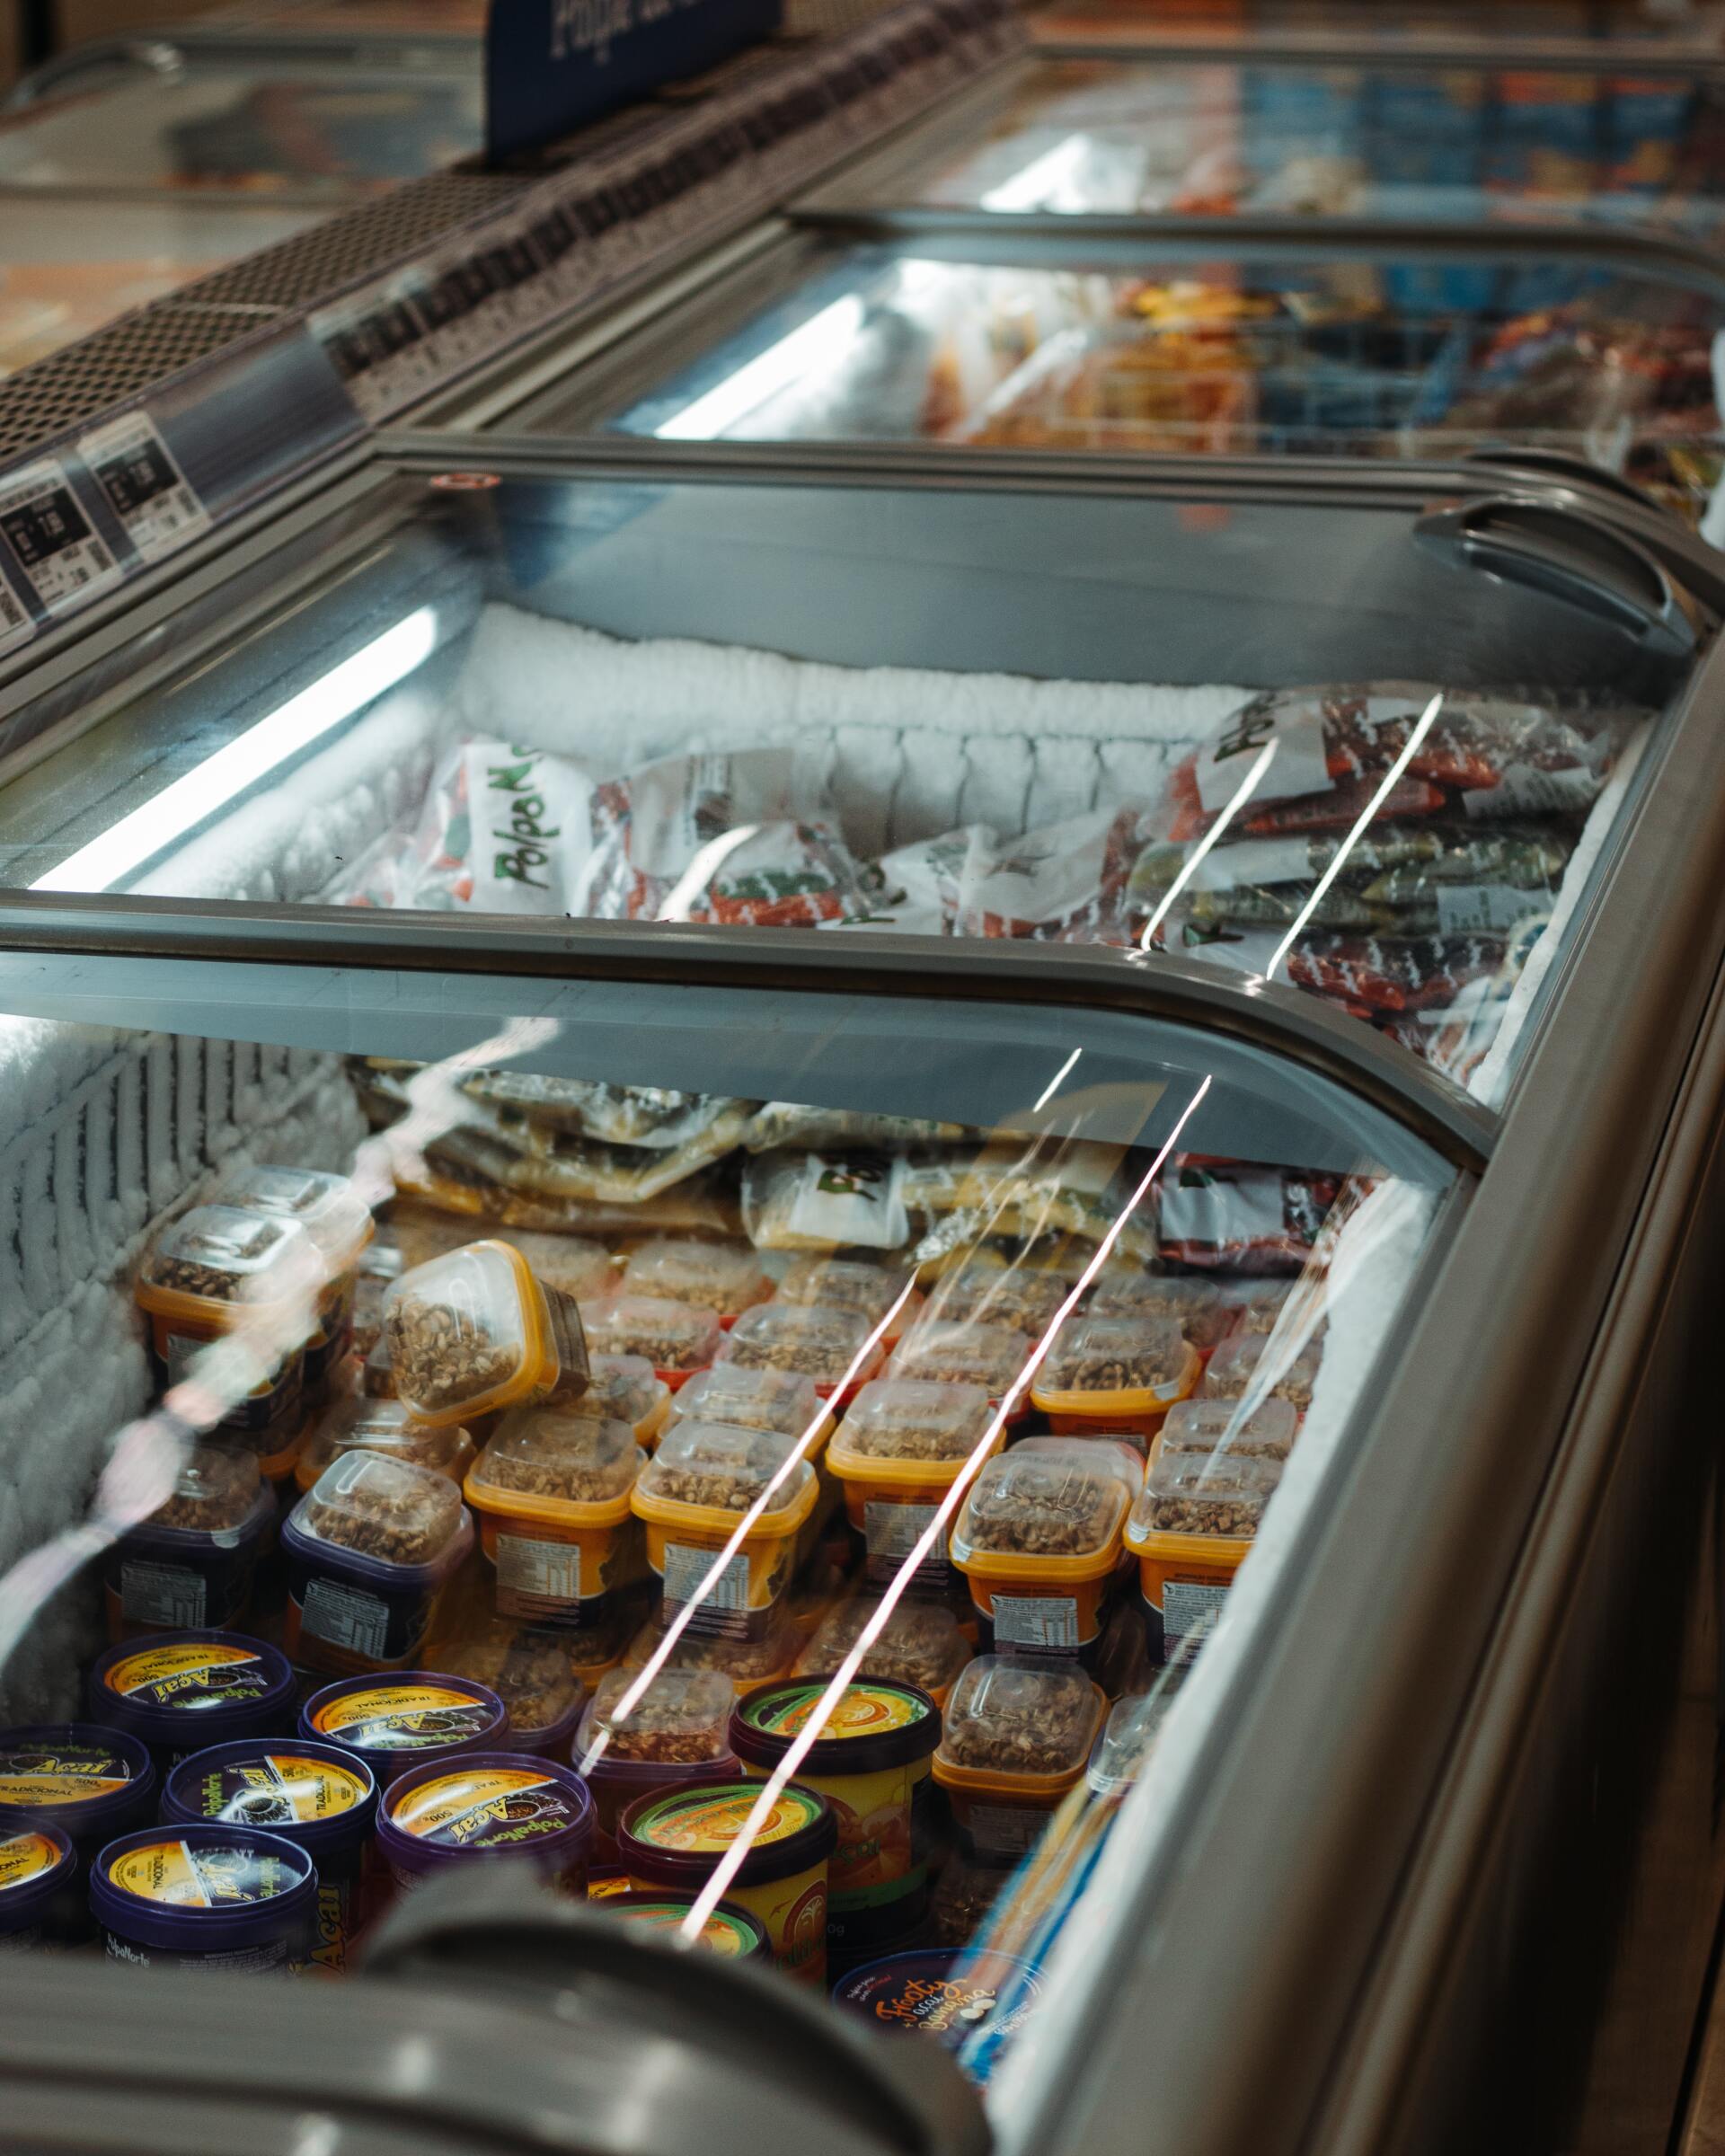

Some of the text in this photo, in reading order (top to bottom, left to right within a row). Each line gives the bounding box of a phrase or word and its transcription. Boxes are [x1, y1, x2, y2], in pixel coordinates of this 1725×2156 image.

[152, 1668, 210, 1703] Açaí
[354, 1696, 431, 1709] TRADICIONAL
[22, 1758, 117, 1776] Açaí
[201, 1771, 229, 1816] PolpaNorte
[422, 1809, 453, 1823] 500g
[448, 1798, 509, 1845] Açaí
[474, 1817, 568, 1847] PolpaNorte
[875, 1977, 969, 2022] Frooty
